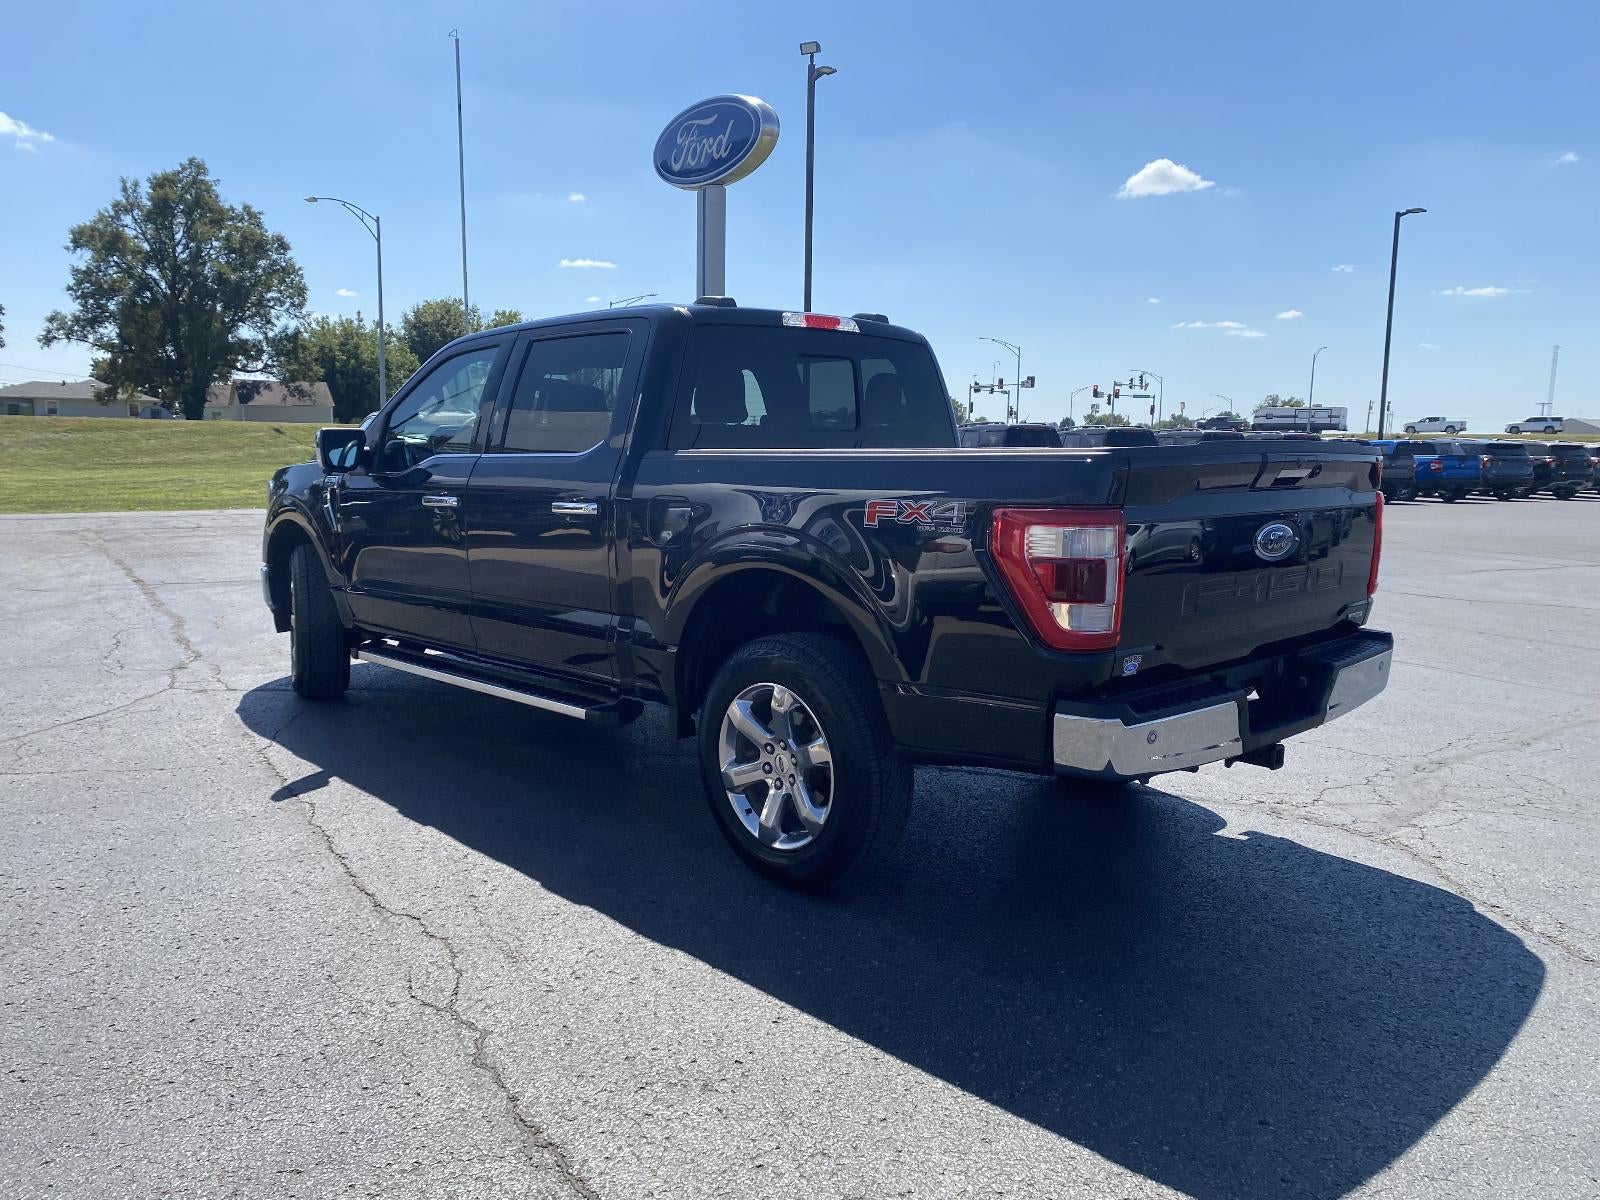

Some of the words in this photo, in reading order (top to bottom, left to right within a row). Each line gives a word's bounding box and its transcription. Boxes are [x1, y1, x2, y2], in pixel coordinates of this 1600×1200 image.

[671, 114, 734, 172] Ford
[864, 499, 966, 528] FX4
[1268, 531, 1289, 549] Ford
